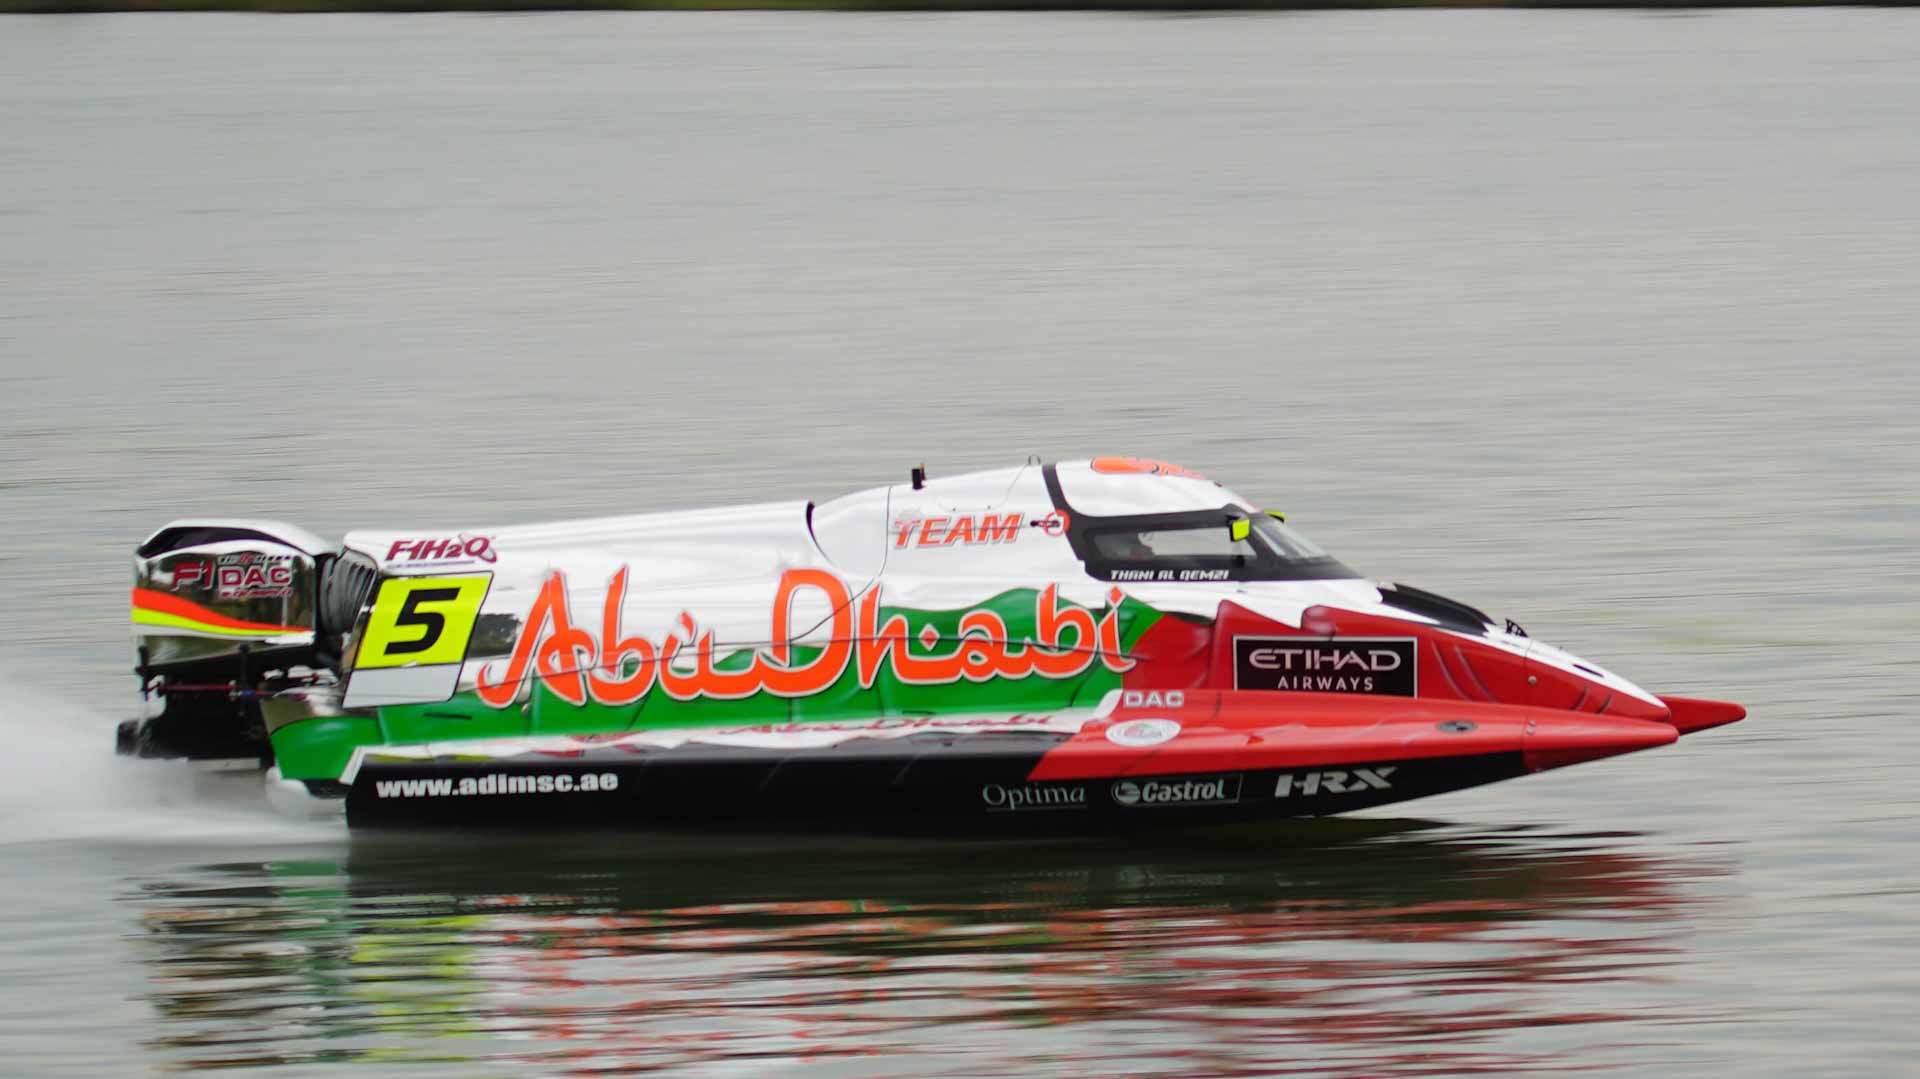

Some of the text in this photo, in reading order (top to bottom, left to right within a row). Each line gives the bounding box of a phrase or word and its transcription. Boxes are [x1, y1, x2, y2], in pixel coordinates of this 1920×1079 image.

[895, 512, 1023, 548] TEAM
[169, 560, 292, 591] F1 DAC
[1111, 569, 1154, 580] THANI
[384, 587, 461, 655] 5
[1248, 648, 1401, 671] ETIHAD
[1277, 675, 1375, 692] AIRWAYS
[1123, 690, 1184, 708] DAC
[376, 772, 619, 799] www.adimsc.ae
[1141, 778, 1225, 803] Castrol
[1274, 766, 1397, 798] HRX
[982, 782, 1087, 811] Optima
